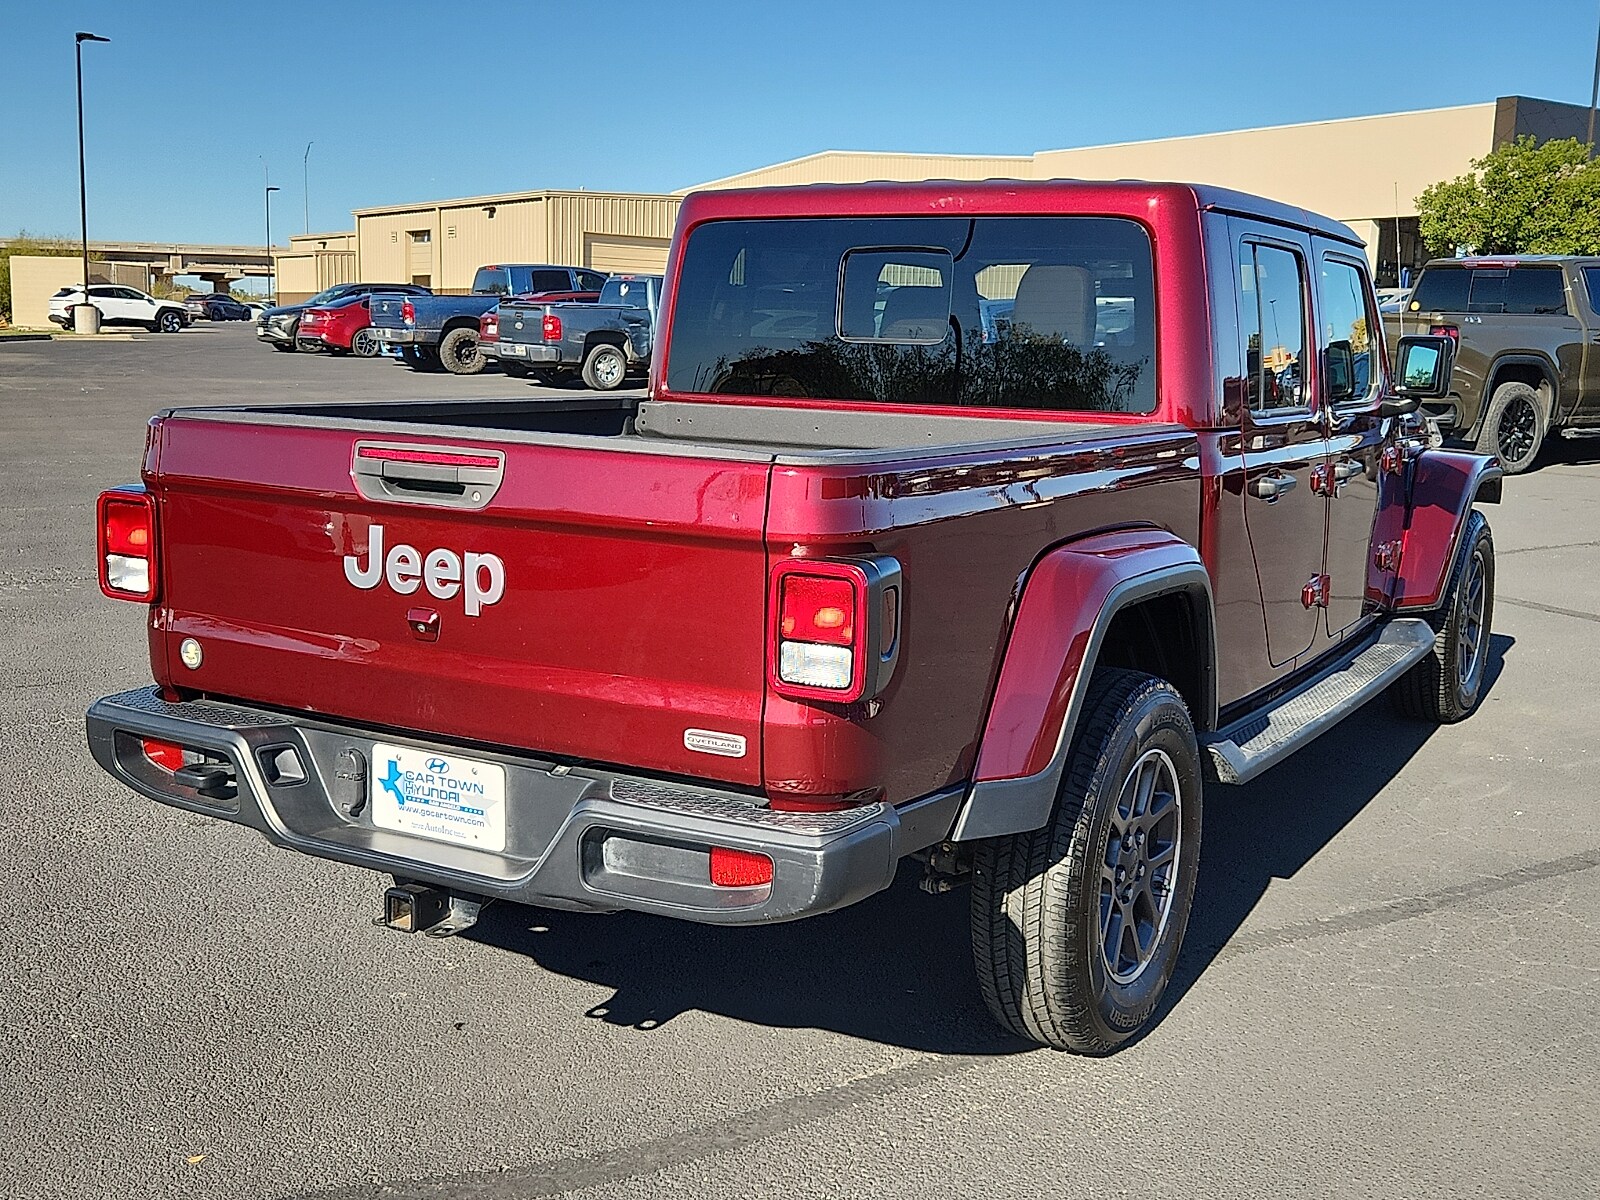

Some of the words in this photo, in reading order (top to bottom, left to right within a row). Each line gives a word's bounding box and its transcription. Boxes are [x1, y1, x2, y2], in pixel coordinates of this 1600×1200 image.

[344, 524, 506, 617] Jeep
[687, 736, 742, 750] OVERLAND
[405, 770, 435, 785] CAR
[439, 776, 484, 795] TOWN
[405, 781, 460, 803] HYUNDAI
[398, 805, 485, 827] www.gocartown.com
